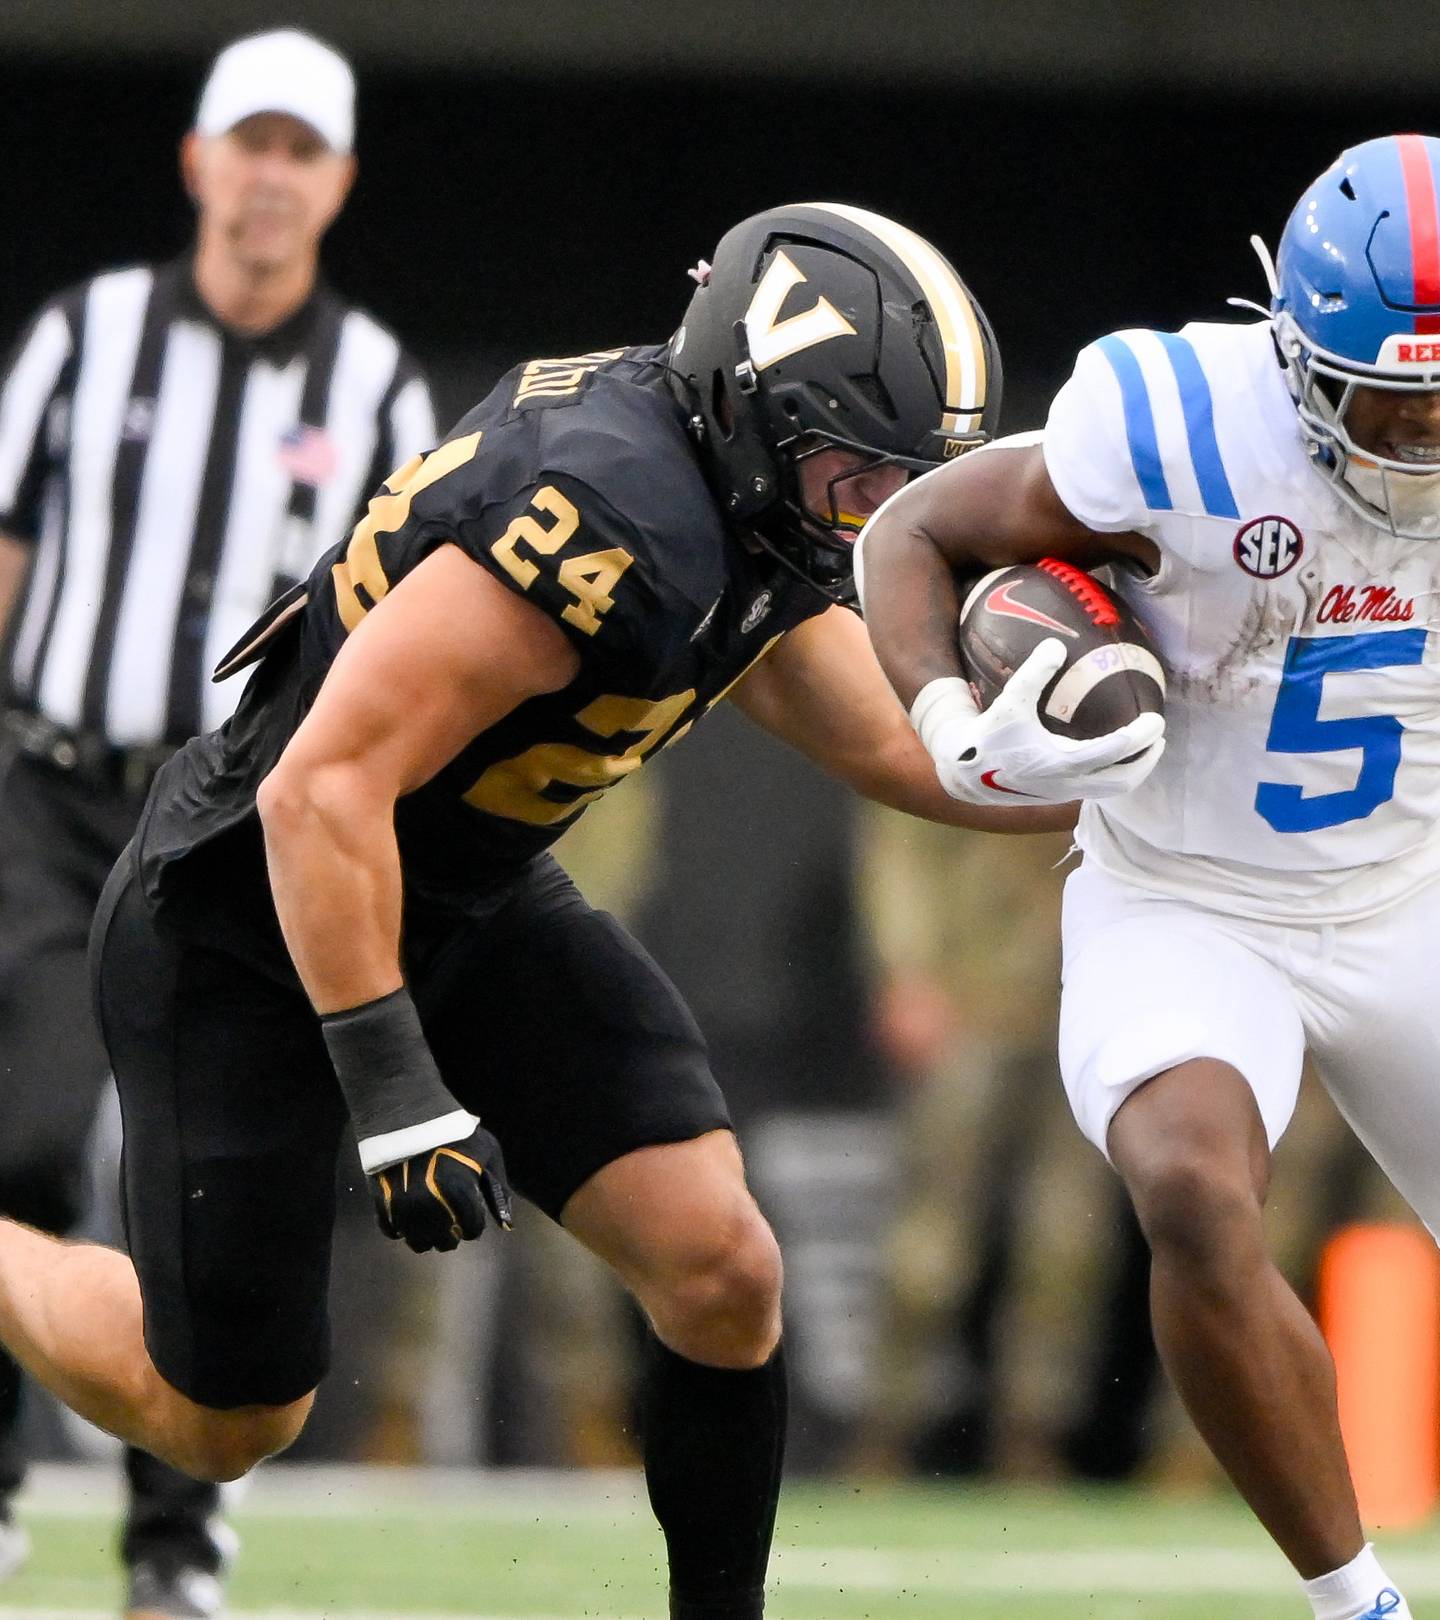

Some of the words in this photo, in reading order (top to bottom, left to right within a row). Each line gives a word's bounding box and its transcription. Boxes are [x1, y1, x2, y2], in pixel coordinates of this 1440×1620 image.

[744, 250, 858, 372] V
[491, 486, 634, 636] 24
[1239, 519, 1301, 576] SEC
[1316, 584, 1357, 624] Ole
[1353, 585, 1415, 622] Miss
[1254, 628, 1429, 833] 5
